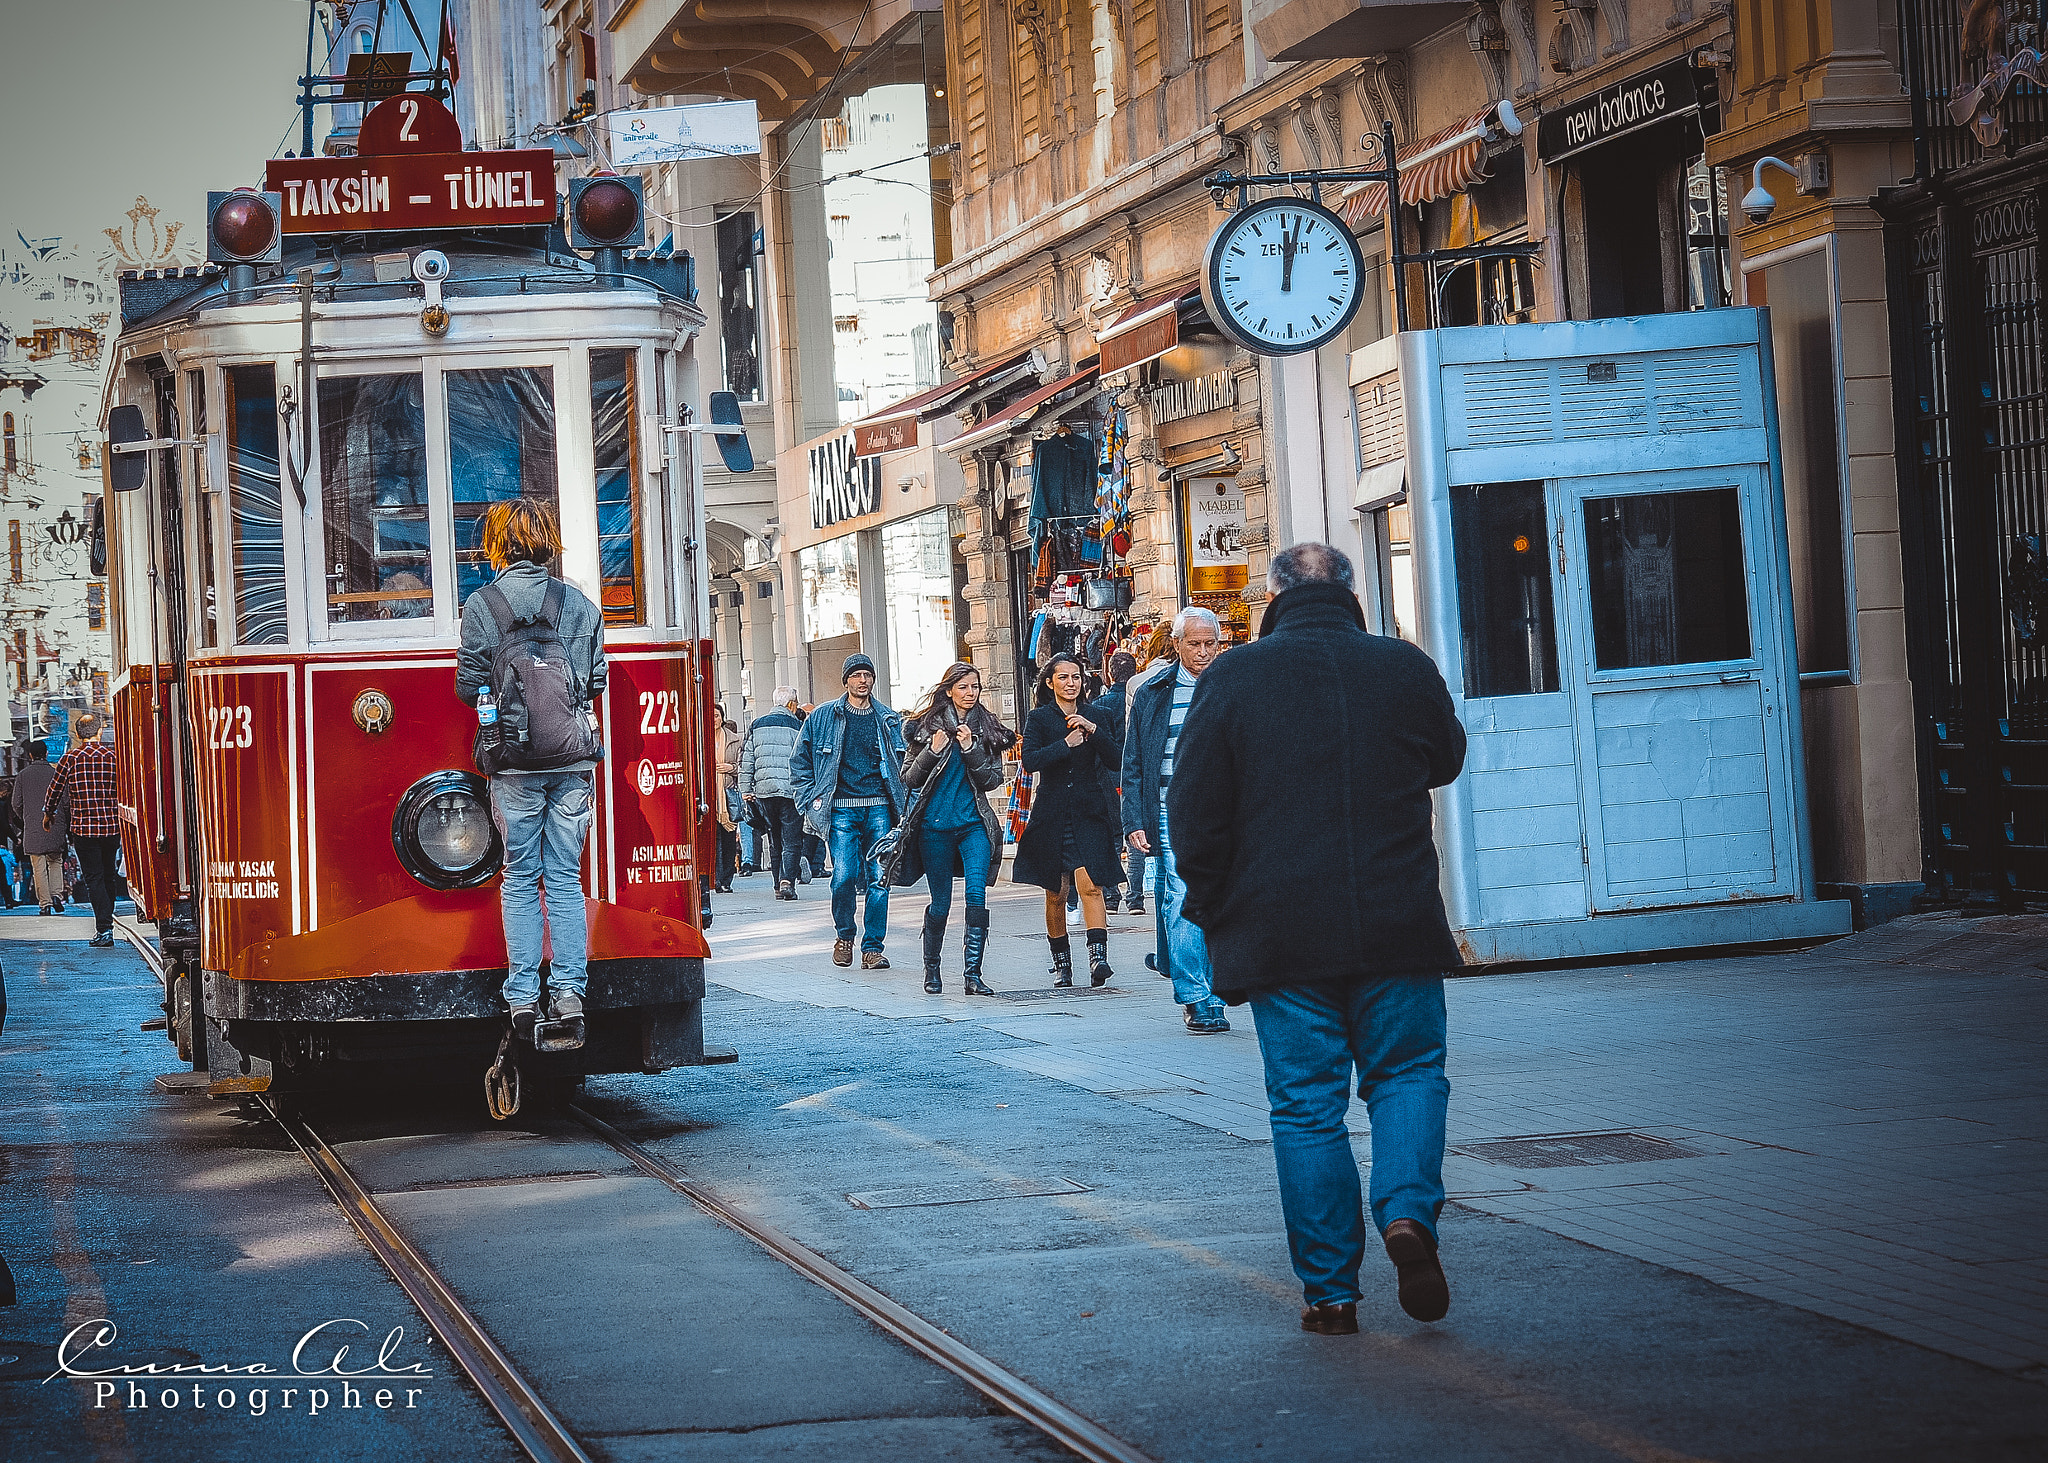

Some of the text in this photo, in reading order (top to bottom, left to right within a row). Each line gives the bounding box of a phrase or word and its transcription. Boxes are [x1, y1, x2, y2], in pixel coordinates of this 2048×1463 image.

[399, 100, 419, 141] 2
[1566, 79, 1666, 146] new balance
[283, 169, 390, 216] TAKSİM
[444, 166, 545, 210] TÜNEL
[808, 429, 879, 529] MANGO
[1198, 499, 1245, 512] MABEL
[208, 705, 253, 749] 223
[639, 689, 680, 735] 223
[238, 860, 276, 878] YASAK
[632, 844, 675, 863] ASILMAK
[626, 867, 643, 884] VE
